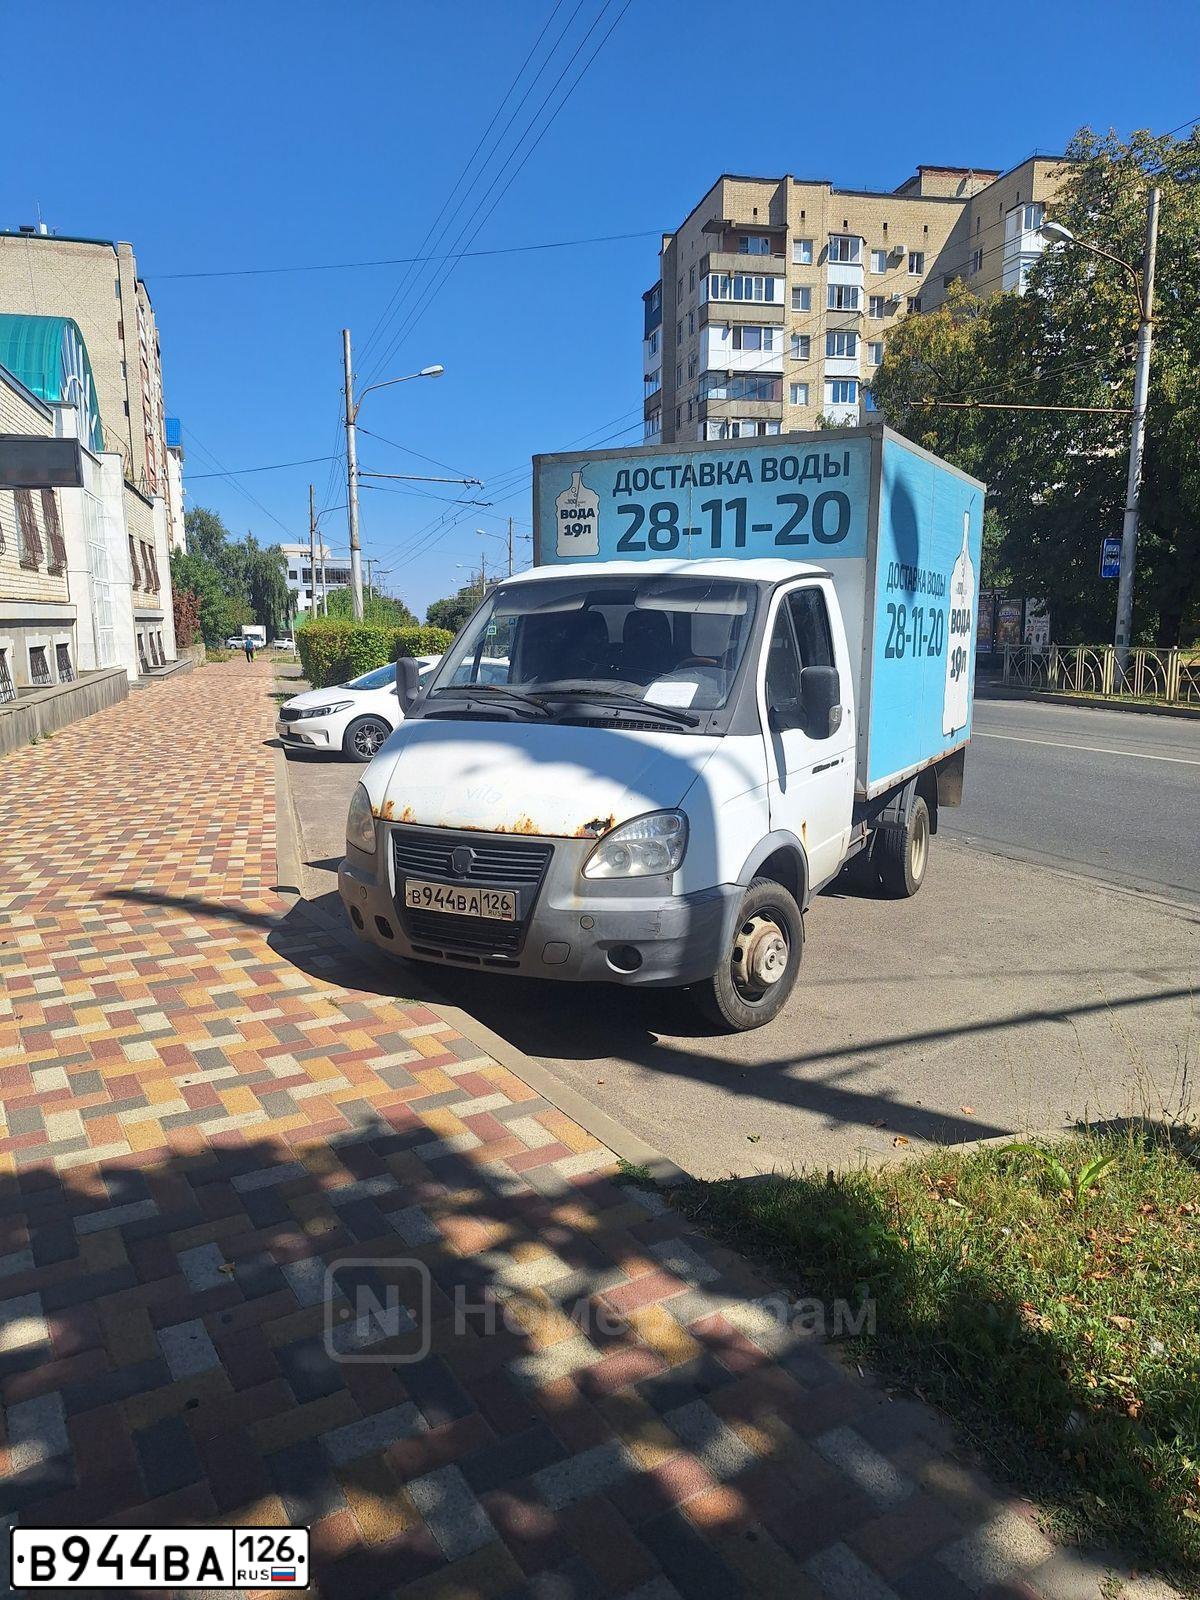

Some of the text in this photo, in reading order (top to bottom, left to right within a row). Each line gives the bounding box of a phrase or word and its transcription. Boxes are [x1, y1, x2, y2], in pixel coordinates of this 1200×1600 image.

[612, 451, 850, 498] ДОСТАВКА ВОДЫ
[560, 507, 596, 520] ВОДА
[616, 490, 851, 553] 28-11-20
[886, 561, 927, 594] ДОСТАВКА
[927, 570, 946, 600] ВОДЫ
[884, 602, 944, 659] 28-11-20
[951, 608, 971, 637] ВОДА
[412, 886, 511, 913] В944ВА 126
[488, 909, 502, 917] RUS
